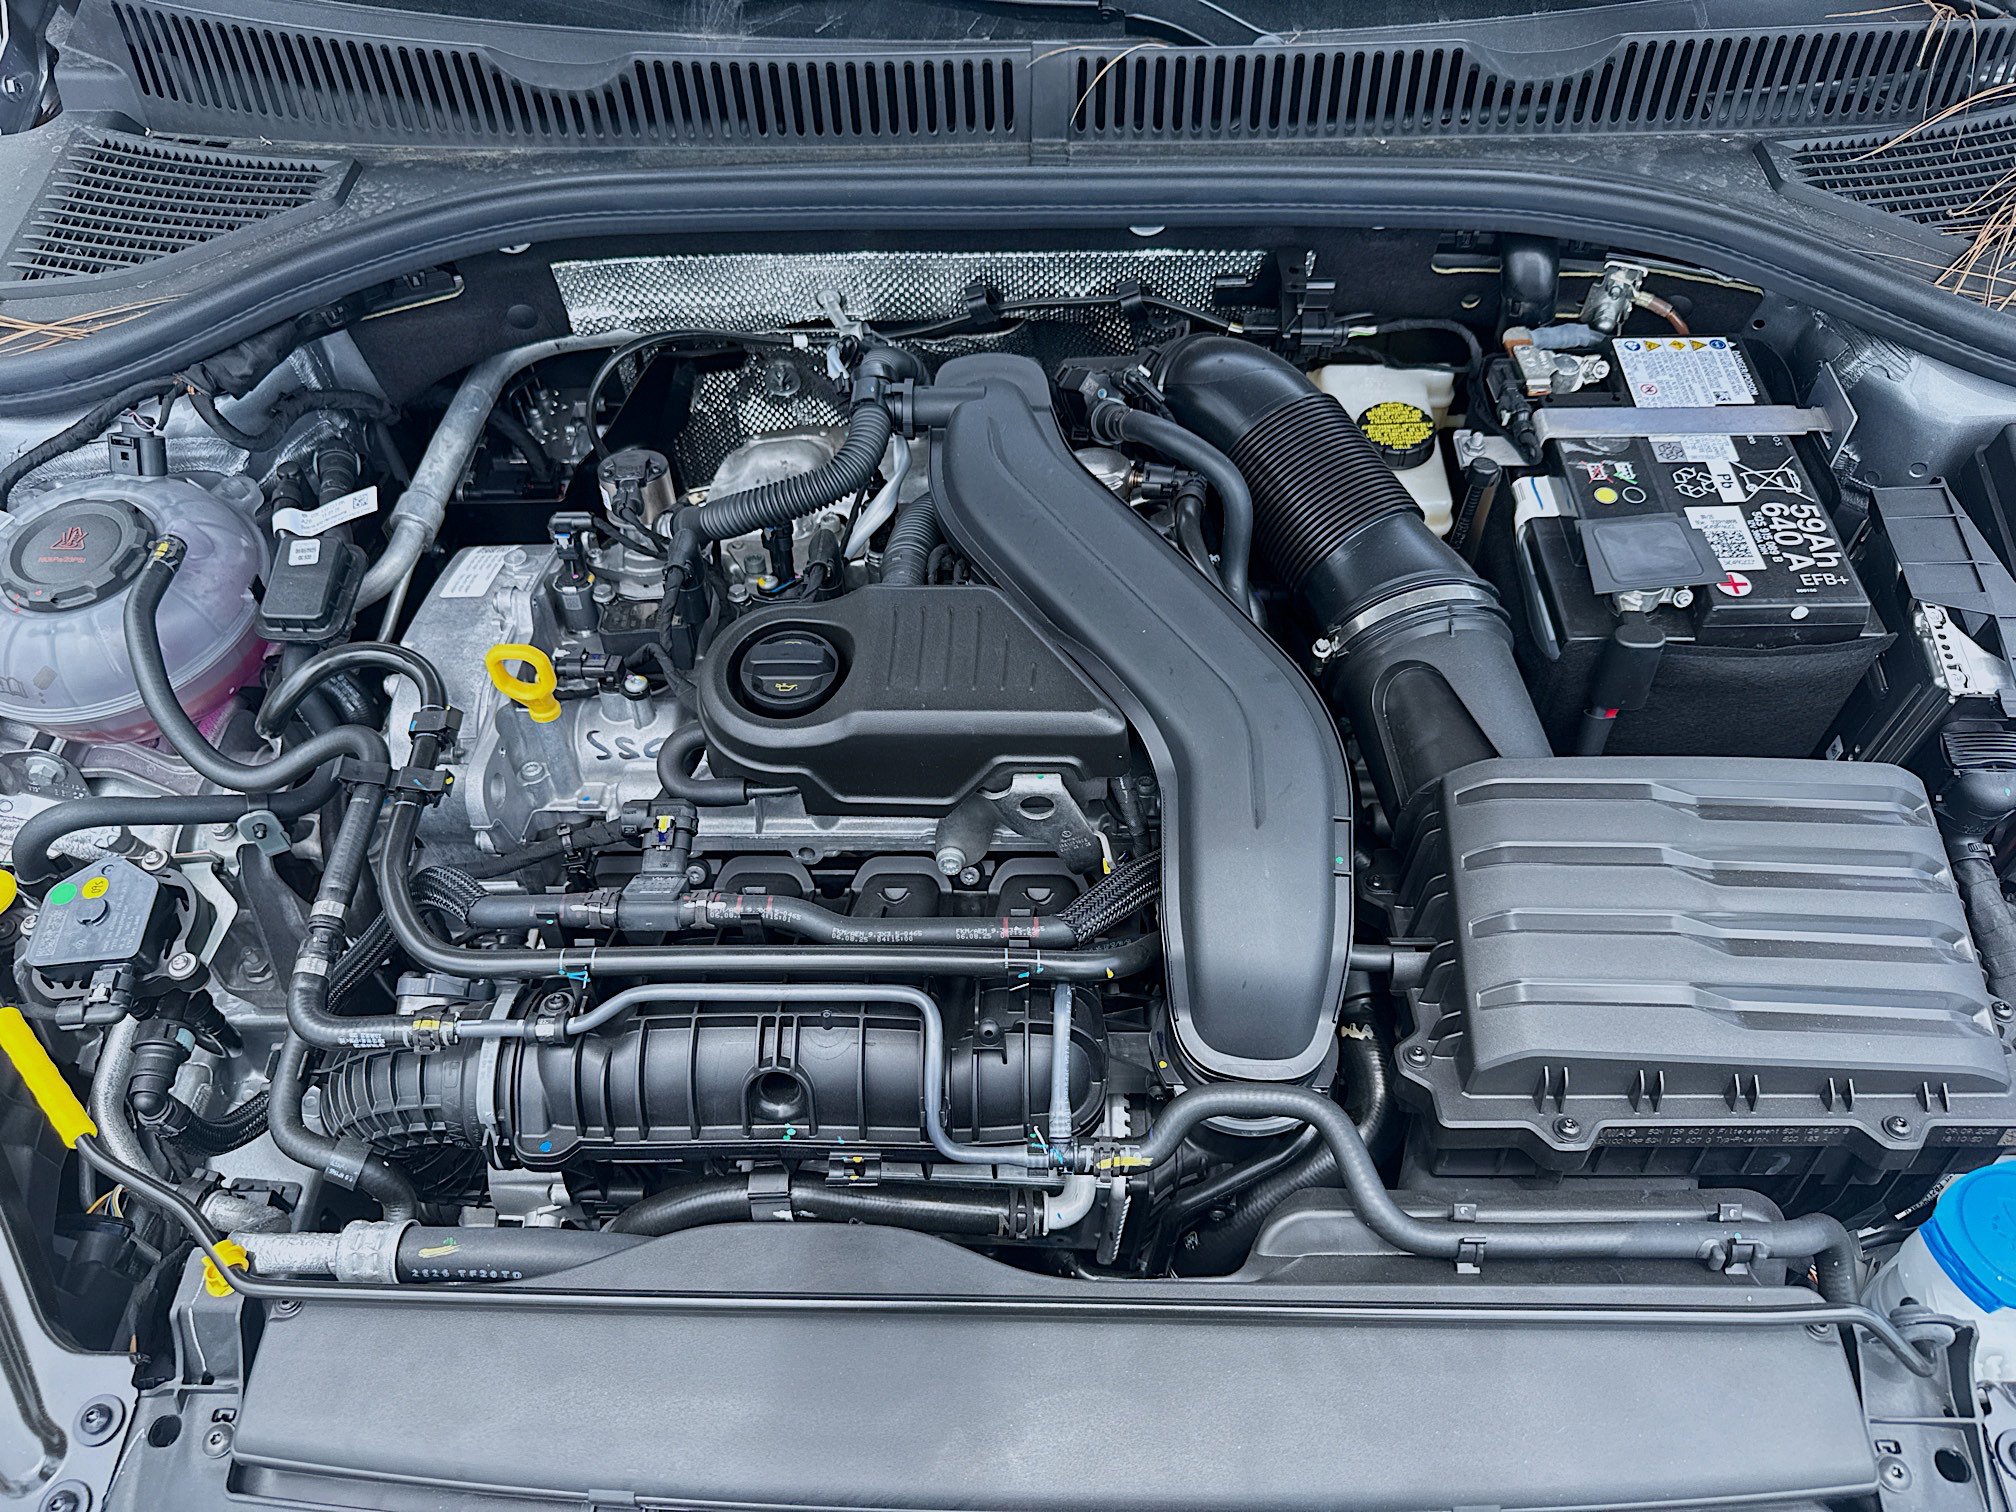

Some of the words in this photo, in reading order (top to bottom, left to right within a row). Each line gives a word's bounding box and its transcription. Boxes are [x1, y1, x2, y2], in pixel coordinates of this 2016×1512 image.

[1716, 473, 1733, 489] Pb
[1760, 502, 1804, 546] 640
[1789, 503, 1842, 568] 59Ah
[1771, 555, 1784, 563] B
[1781, 551, 1816, 572] A
[1799, 572, 1850, 586] EFB+
[831, 932, 869, 943] 06.08.25
